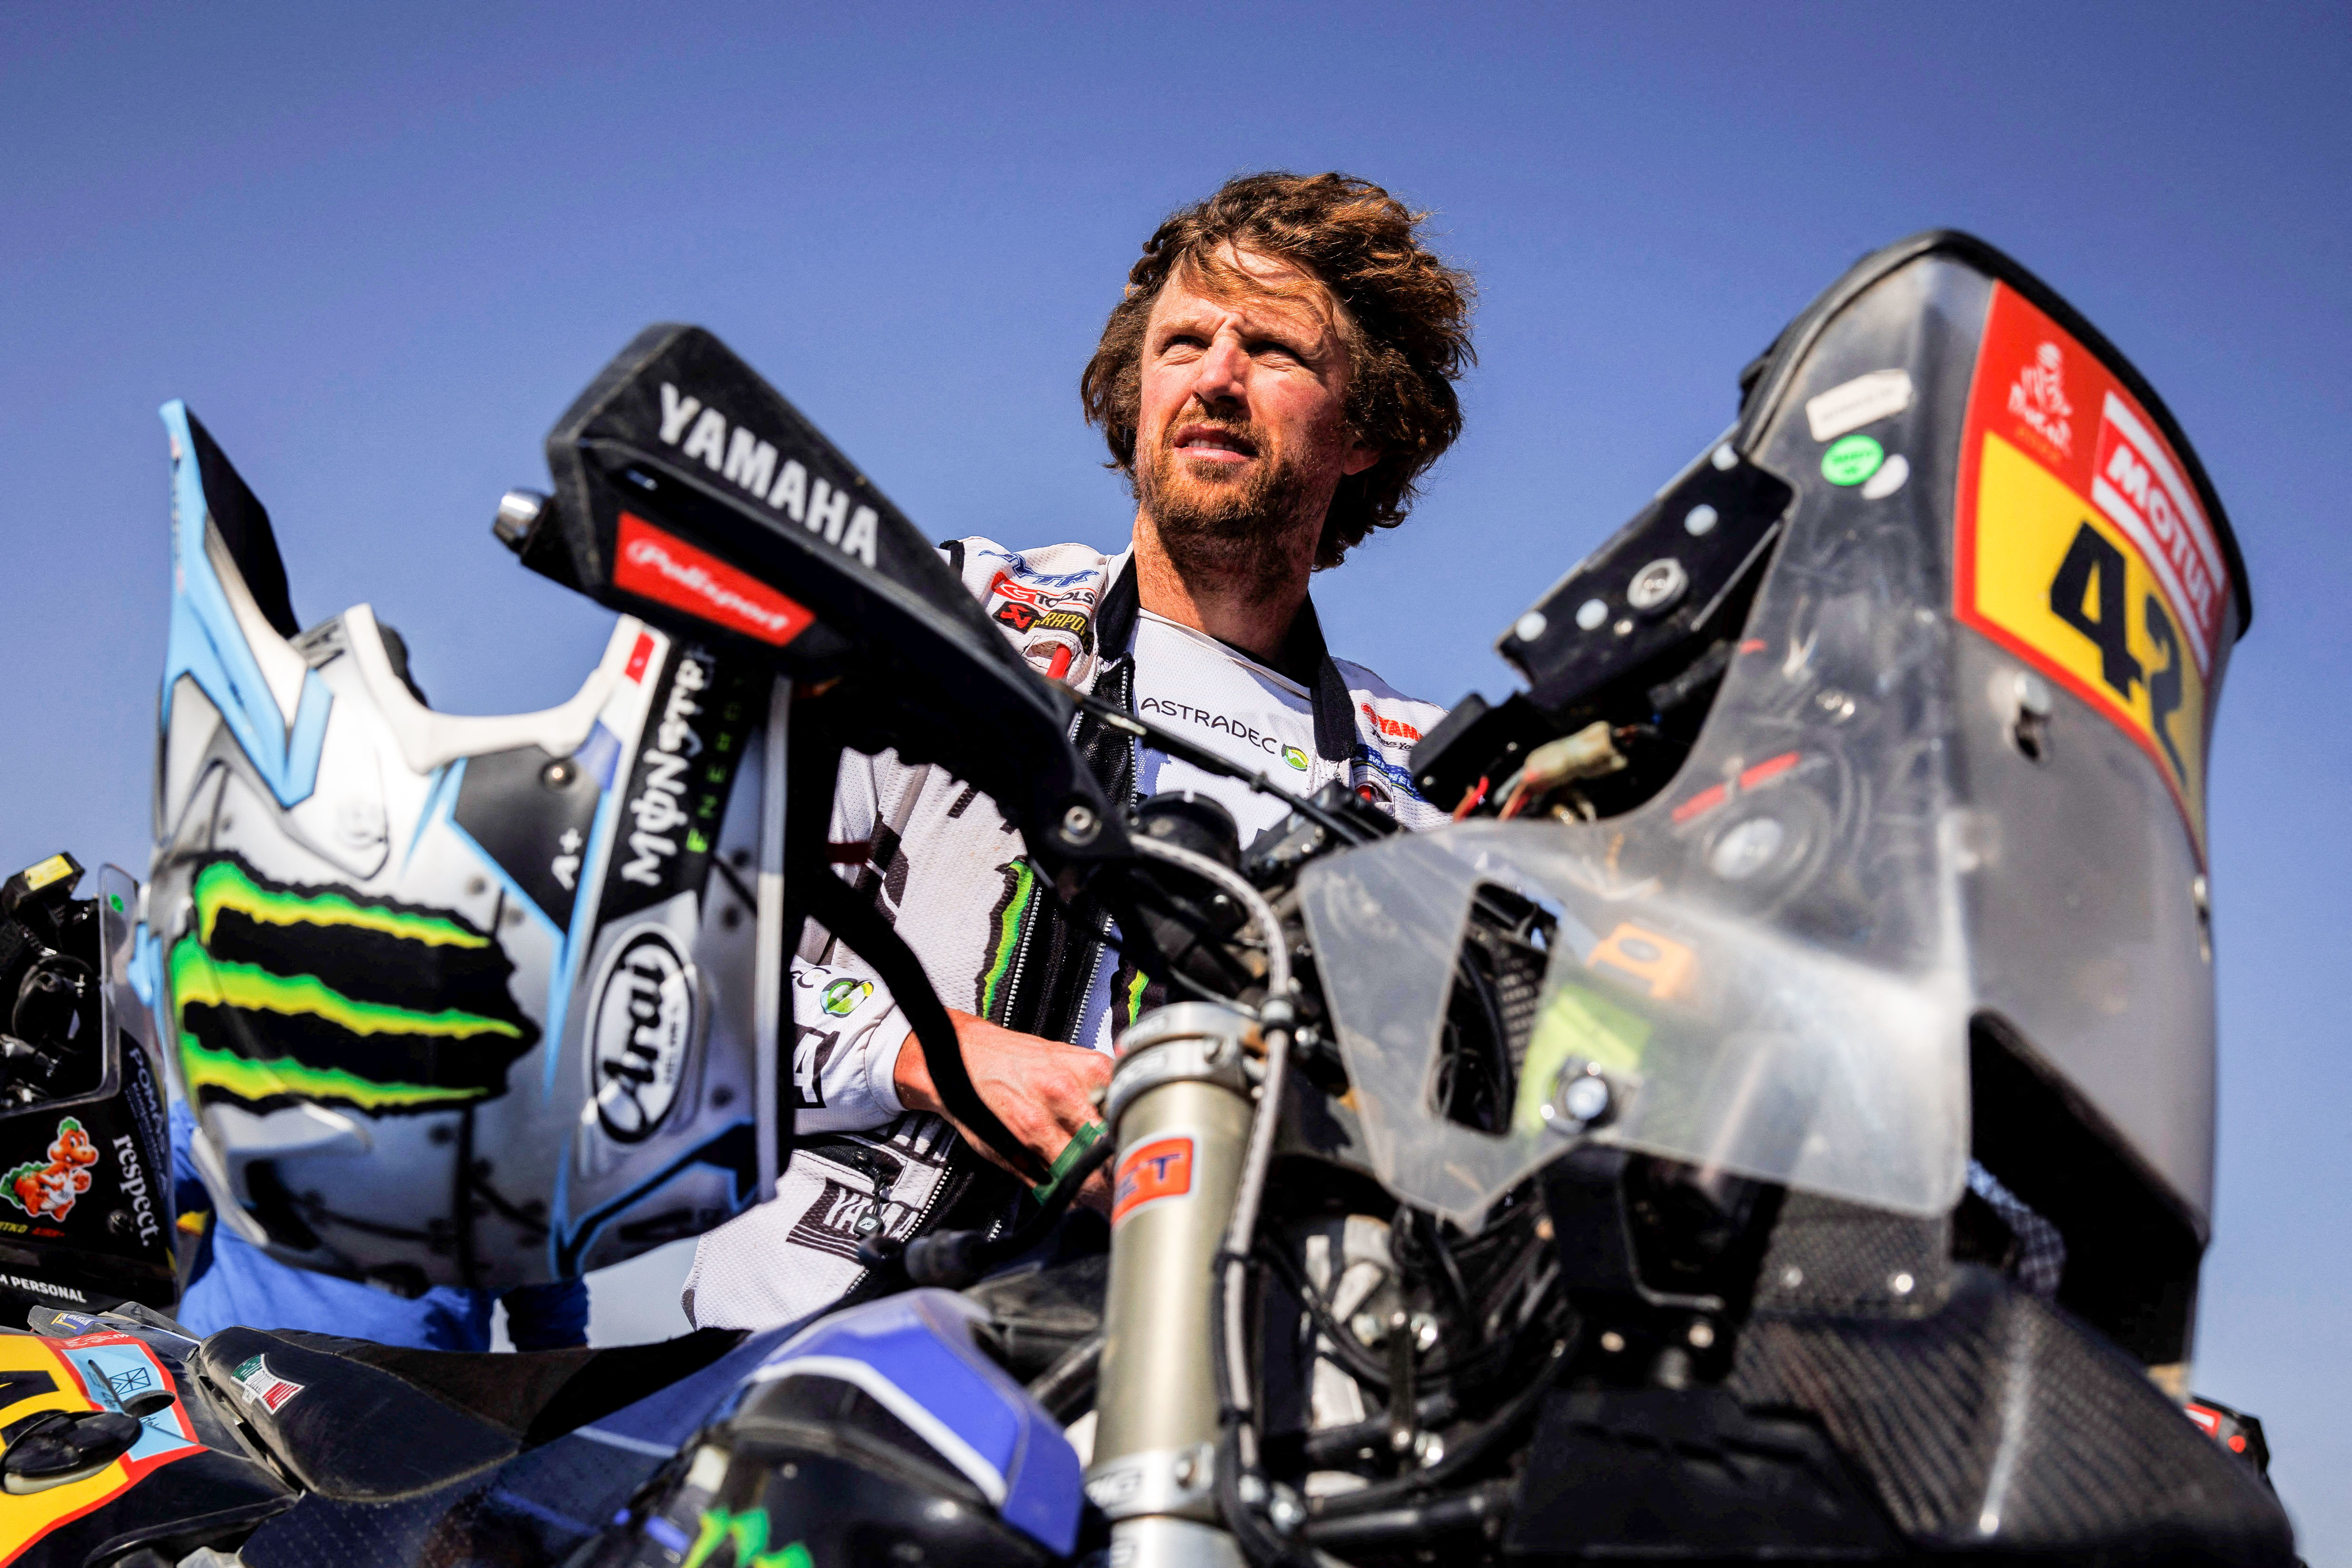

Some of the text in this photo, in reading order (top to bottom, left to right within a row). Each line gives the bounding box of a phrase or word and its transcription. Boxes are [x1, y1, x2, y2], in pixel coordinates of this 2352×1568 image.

[657, 382, 879, 568] YAMAHA
[2107, 445, 2210, 628] MOTUL
[1035, 590, 1096, 608] TOOLS
[2049, 521, 2187, 787] 42
[1140, 697, 1277, 755] ASTRADEC
[1376, 714, 1423, 741] YAM
[112, 1134, 160, 1247] respect.
[10, 1275, 87, 1303] PERSONAL
